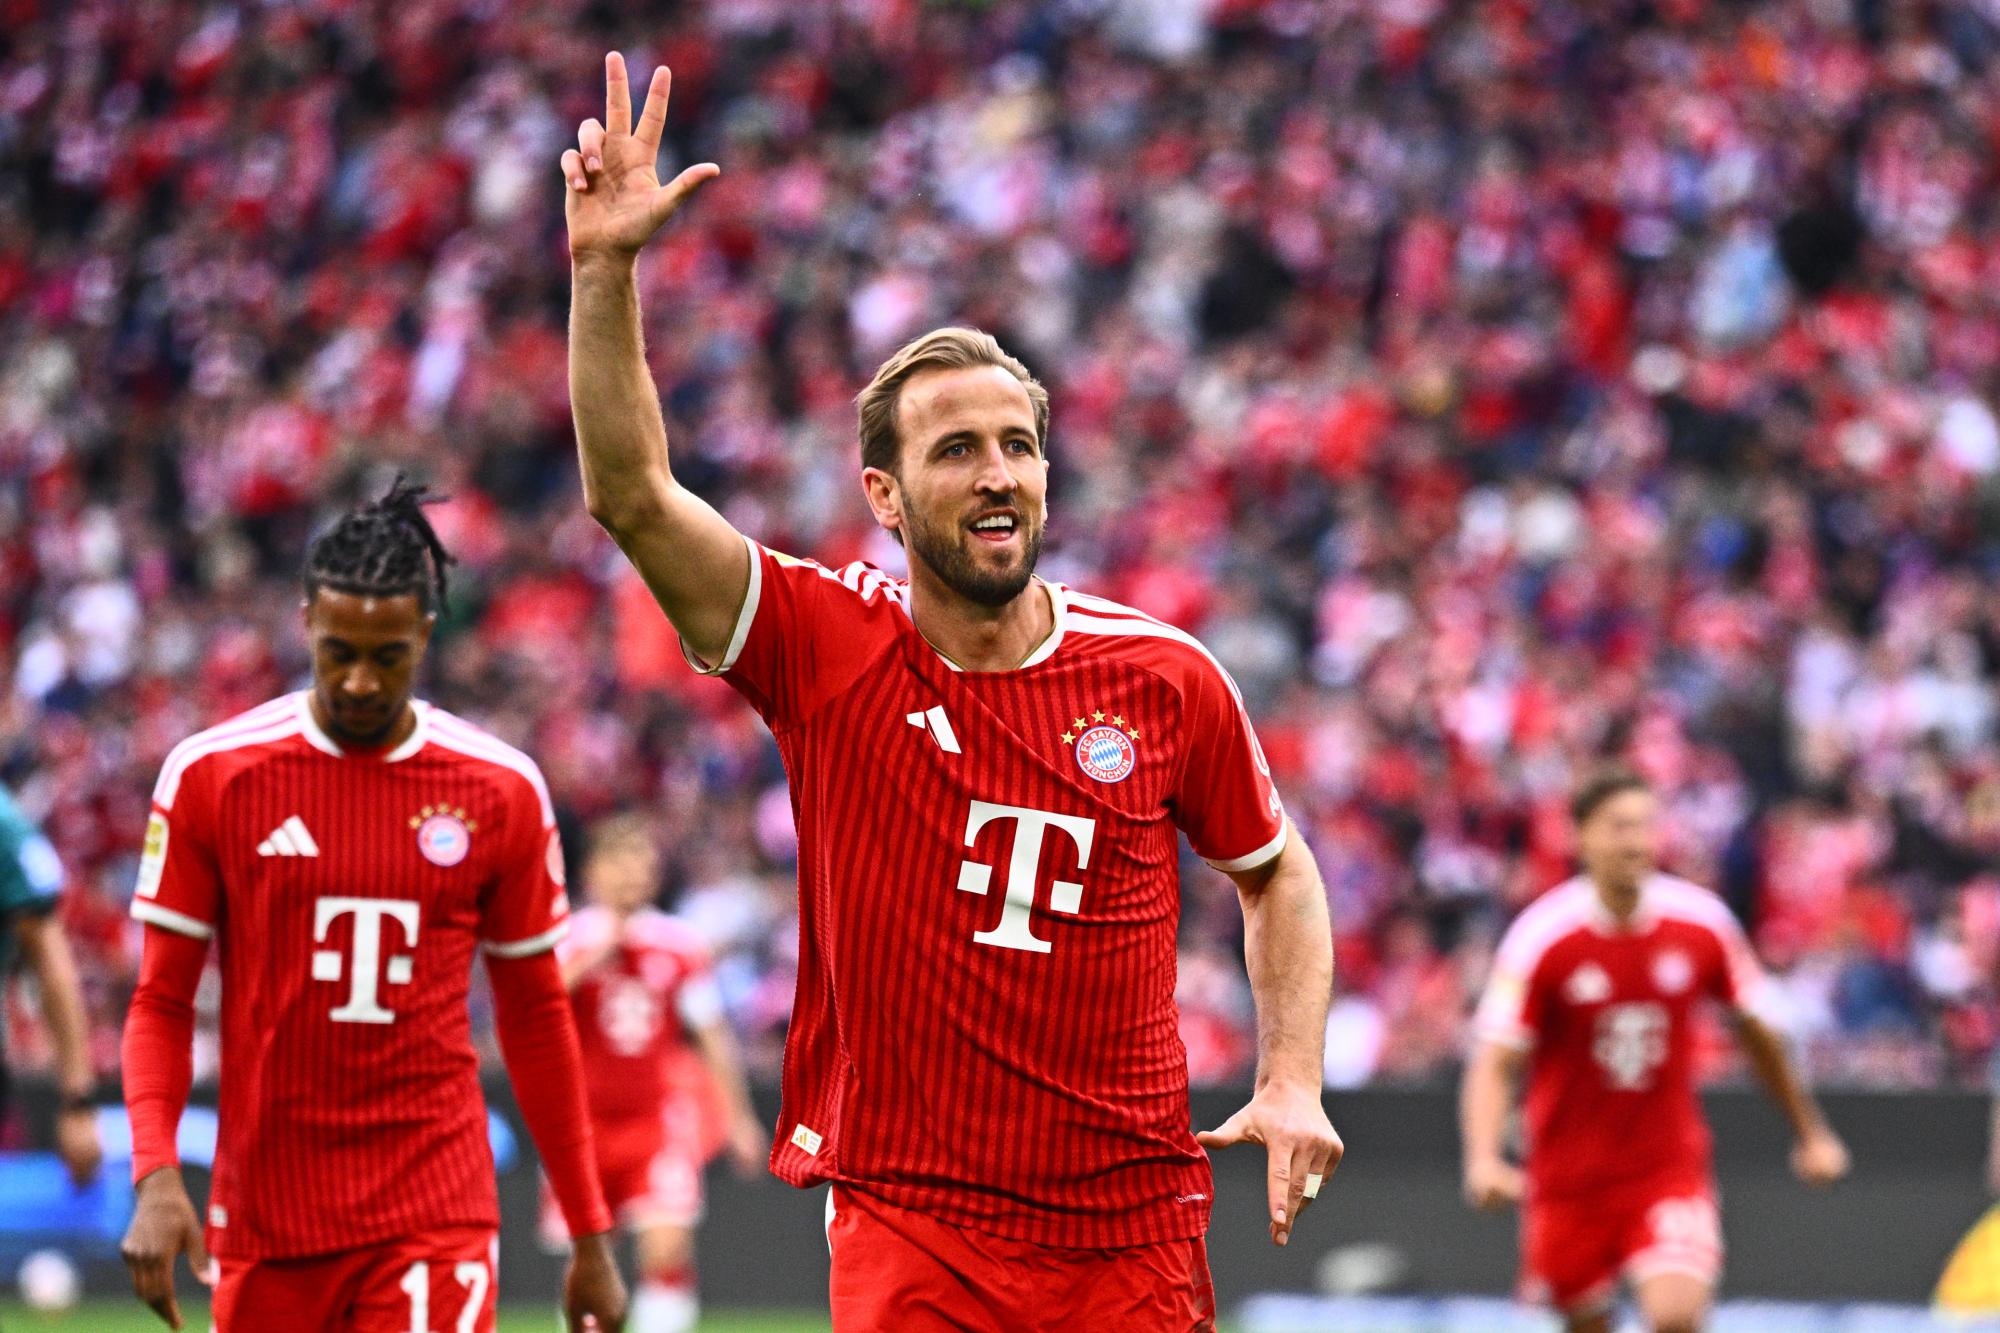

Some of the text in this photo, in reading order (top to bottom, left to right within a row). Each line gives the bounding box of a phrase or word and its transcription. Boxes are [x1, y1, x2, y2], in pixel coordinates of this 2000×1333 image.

[1081, 730, 1129, 753] FC BAYERN
[957, 800, 1096, 954] T
[312, 897, 420, 1024] T
[400, 1261, 489, 1333] 17
